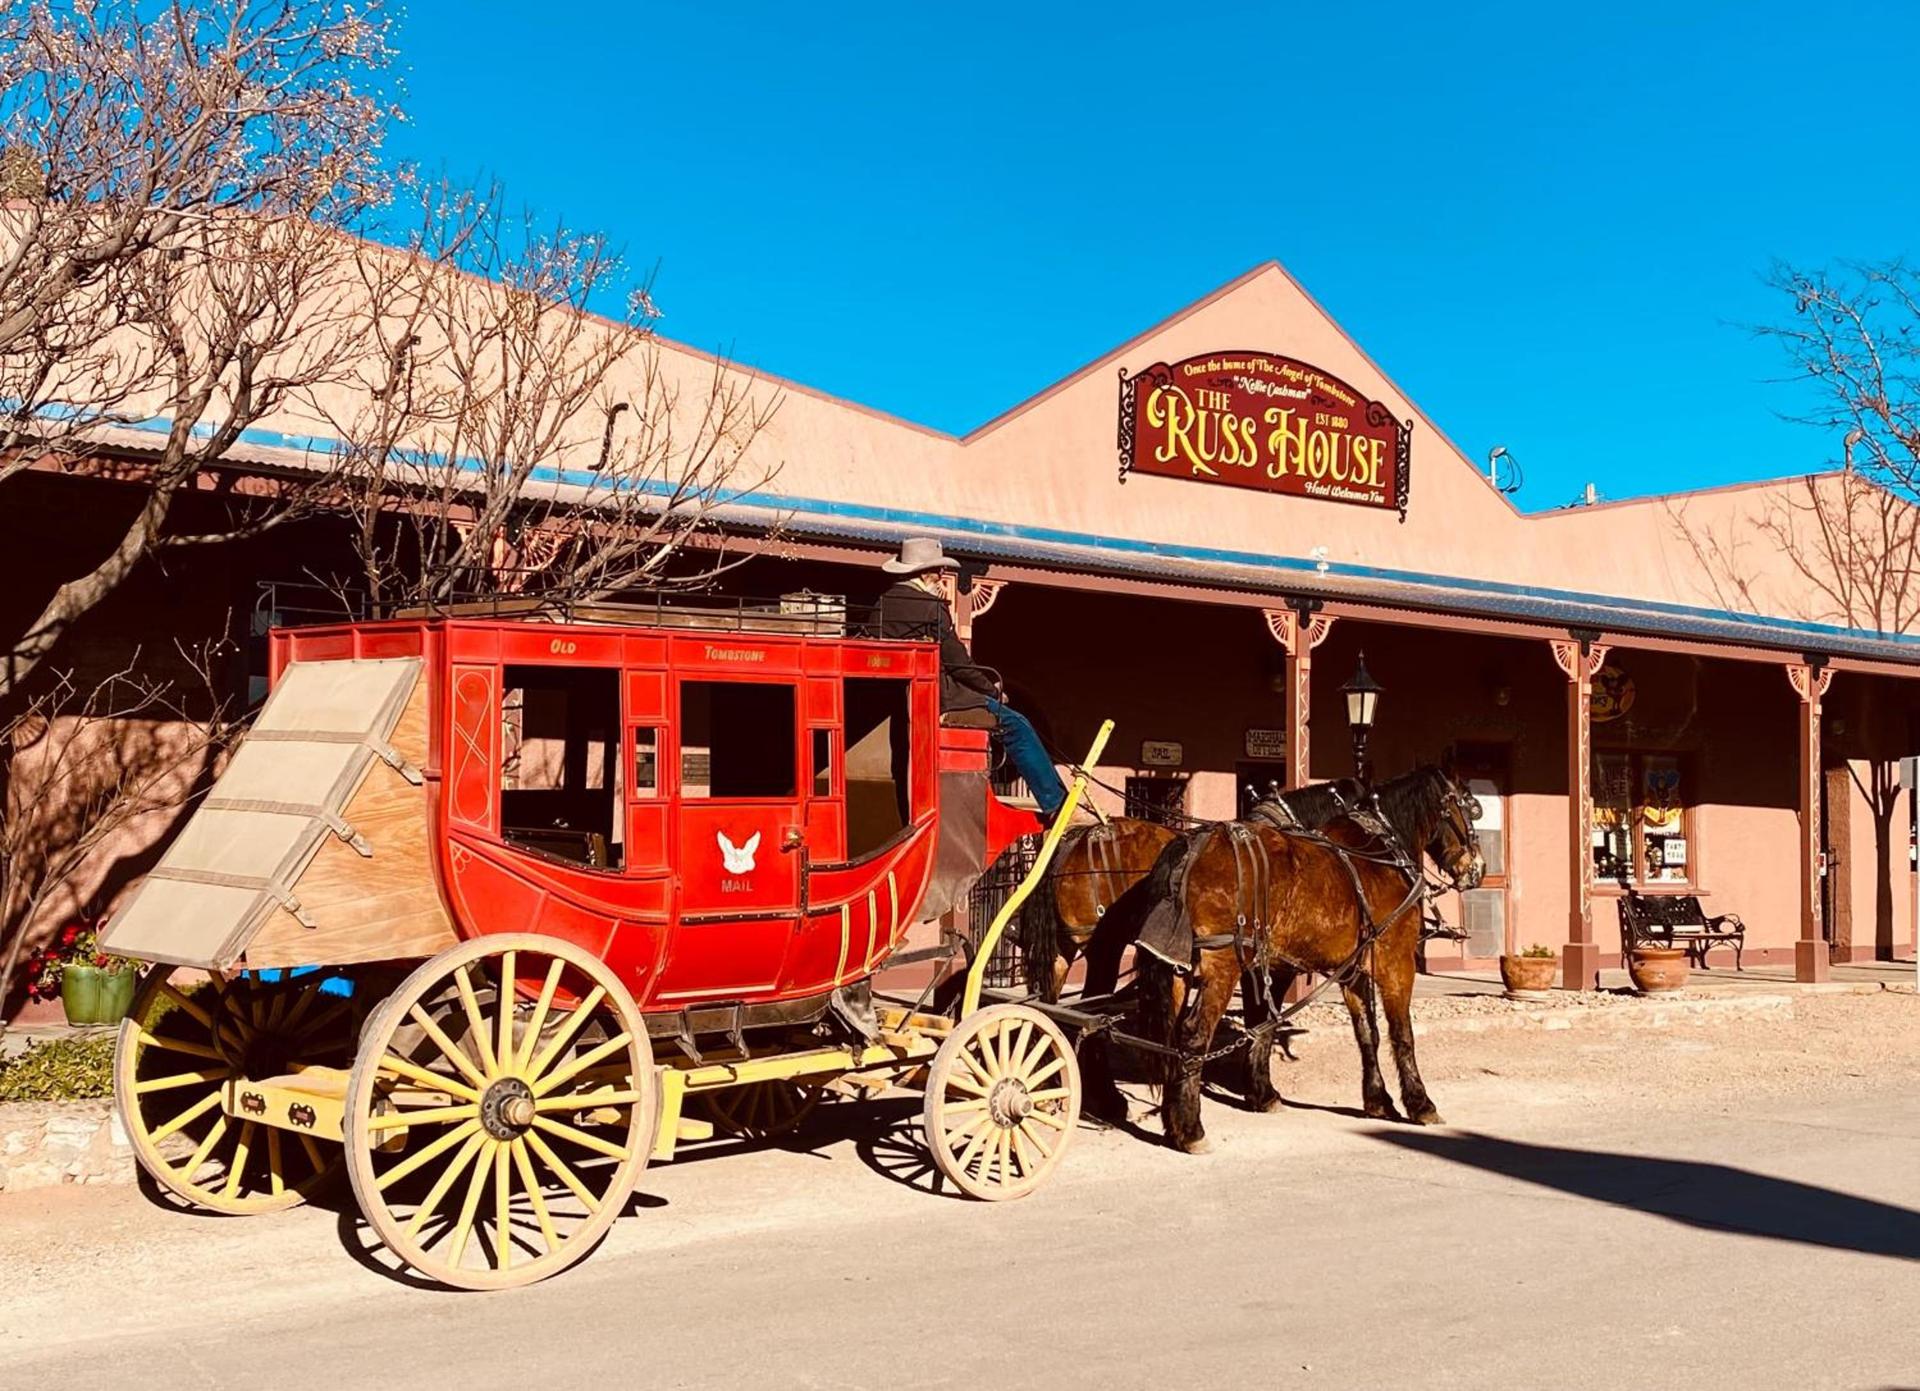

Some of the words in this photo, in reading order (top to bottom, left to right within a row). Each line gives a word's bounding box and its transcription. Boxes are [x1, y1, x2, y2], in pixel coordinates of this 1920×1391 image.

[1184, 363, 1206, 376] Once
[1208, 360, 1221, 372] the
[1222, 359, 1246, 370] home
[1247, 359, 1256, 374] of
[1255, 359, 1274, 373] The
[1274, 362, 1304, 382] Angel
[1304, 373, 1314, 387] of
[1313, 375, 1356, 407] Tombstone
[1195, 388, 1232, 412] THE
[1315, 412, 1330, 427] EST
[1147, 384, 1259, 476] RUSS
[1263, 407, 1387, 488] HOUSE
[1304, 480, 1331, 496] Hotel
[1331, 485, 1369, 501] Welcomes
[1369, 490, 1385, 504] You
[721, 879, 754, 893] MAIL
